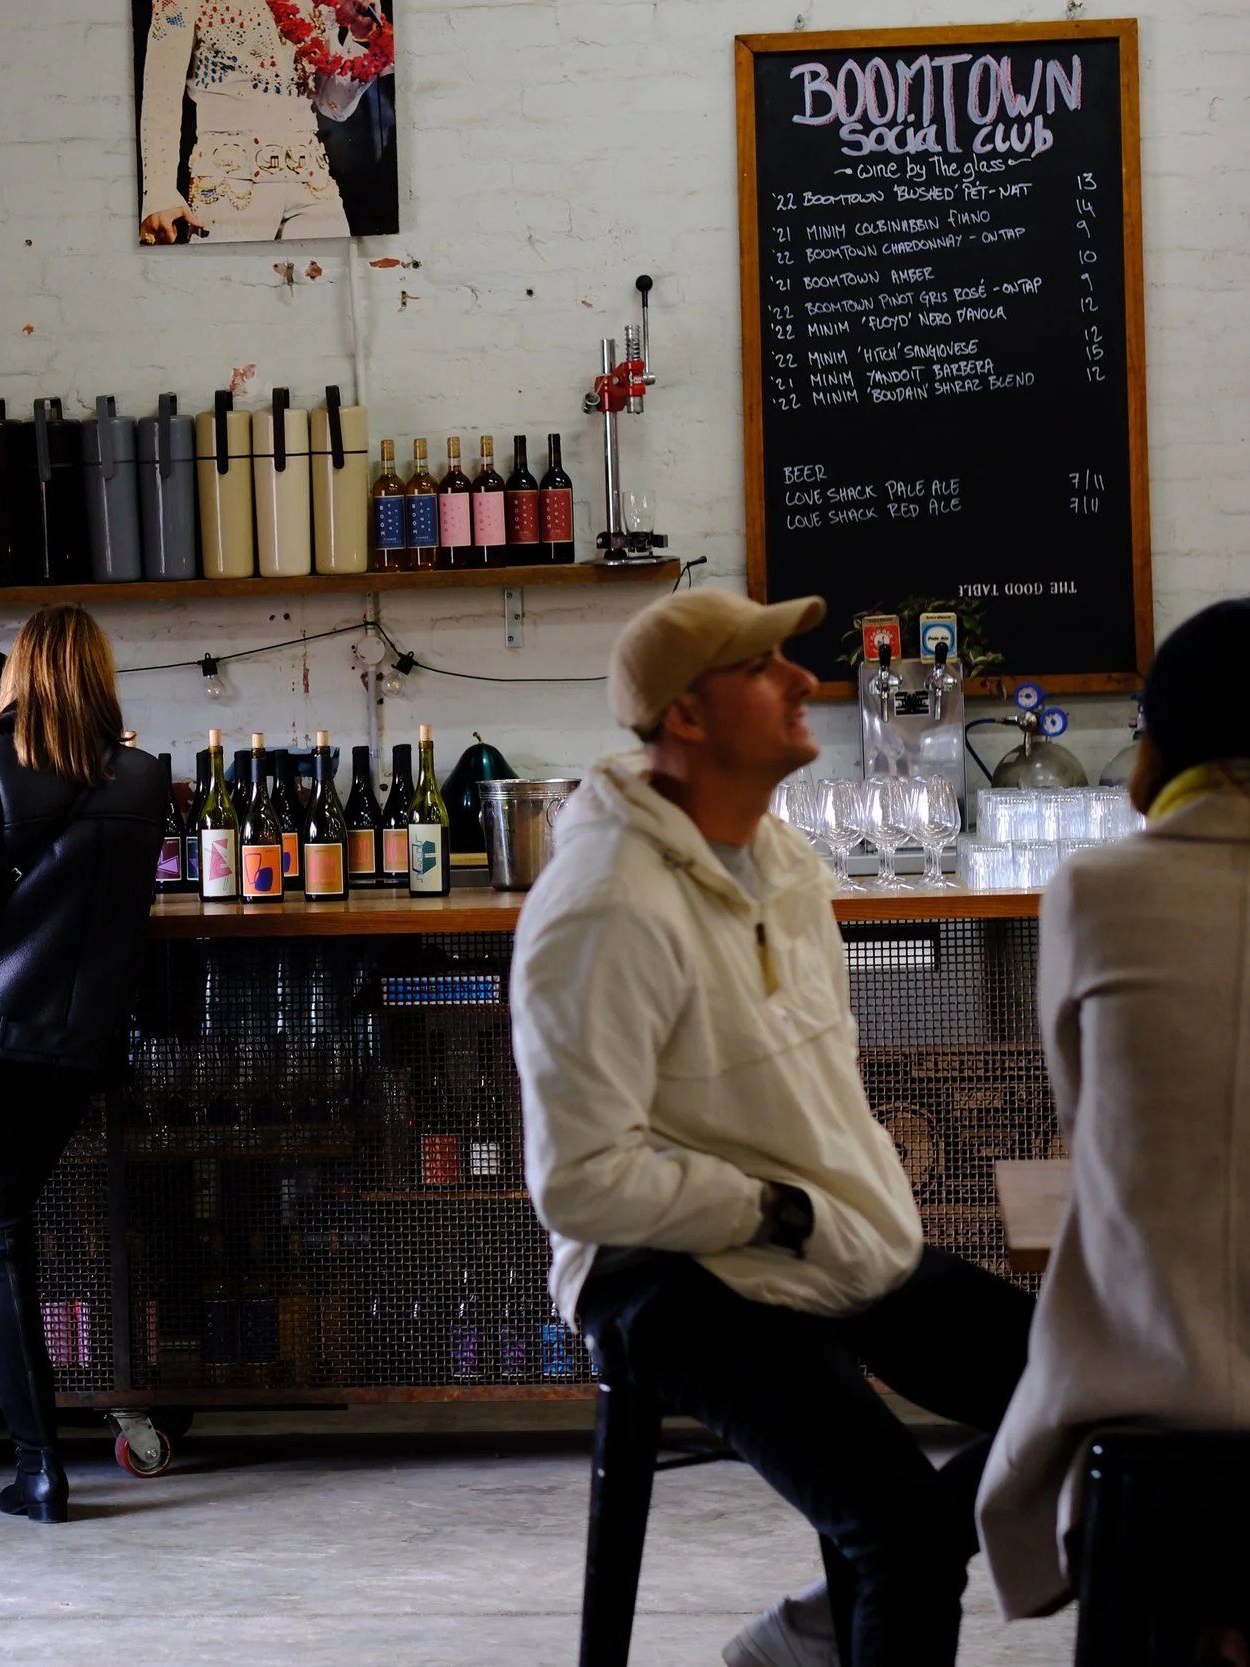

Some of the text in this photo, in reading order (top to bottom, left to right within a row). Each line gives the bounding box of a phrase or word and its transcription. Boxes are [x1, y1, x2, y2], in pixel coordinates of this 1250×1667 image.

[789, 53, 1082, 130] BOOMTOWN
[857, 161, 900, 179] wine
[906, 157, 926, 181] by
[963, 153, 1006, 182] glass
[803, 190, 884, 206] BOOMTOWN
[1077, 172, 1097, 190] 13
[806, 224, 846, 240] MINIM
[855, 216, 939, 236] COLBINABBIN
[1076, 199, 1096, 217] 14
[806, 244, 877, 263] BOOMTOWN
[882, 234, 962, 255] CHARDONNAY
[1076, 219, 1091, 238] 9
[803, 271, 880, 289] BOOMTOWN
[891, 266, 935, 284] AMBER
[1079, 250, 1097, 264] 10
[805, 297, 874, 316] BOOMTOWN
[879, 292, 914, 310] PINOT
[919, 290, 948, 308] GRIS
[954, 278, 987, 302] ROSÉ
[808, 320, 850, 337] MINIM
[919, 311, 951, 327] NERO
[1081, 297, 1098, 312] 12
[808, 349, 848, 369] MINIM
[904, 339, 978, 361] SANGIOVESE
[1085, 325, 1103, 343] 12
[810, 370, 855, 387] MINIM
[866, 366, 925, 386] YANDOIT
[932, 358, 994, 380] BARBERA
[1086, 344, 1104, 361] 15
[812, 389, 859, 406] MINIM
[934, 379, 983, 396] SHIRAZ
[988, 372, 1035, 390] BLEND
[1086, 366, 1105, 382] 12
[783, 464, 827, 484] BEER
[785, 489, 823, 506] LOVE
[827, 484, 878, 503] SHACK
[885, 480, 925, 500] PALE
[931, 478, 960, 496] ALE
[786, 511, 822, 530] LOVE
[828, 507, 878, 524] SHACK
[887, 502, 920, 518] RED
[928, 498, 962, 515] ALE
[1005, 582, 1043, 596] GOOD
[1050, 581, 1077, 594] THE
